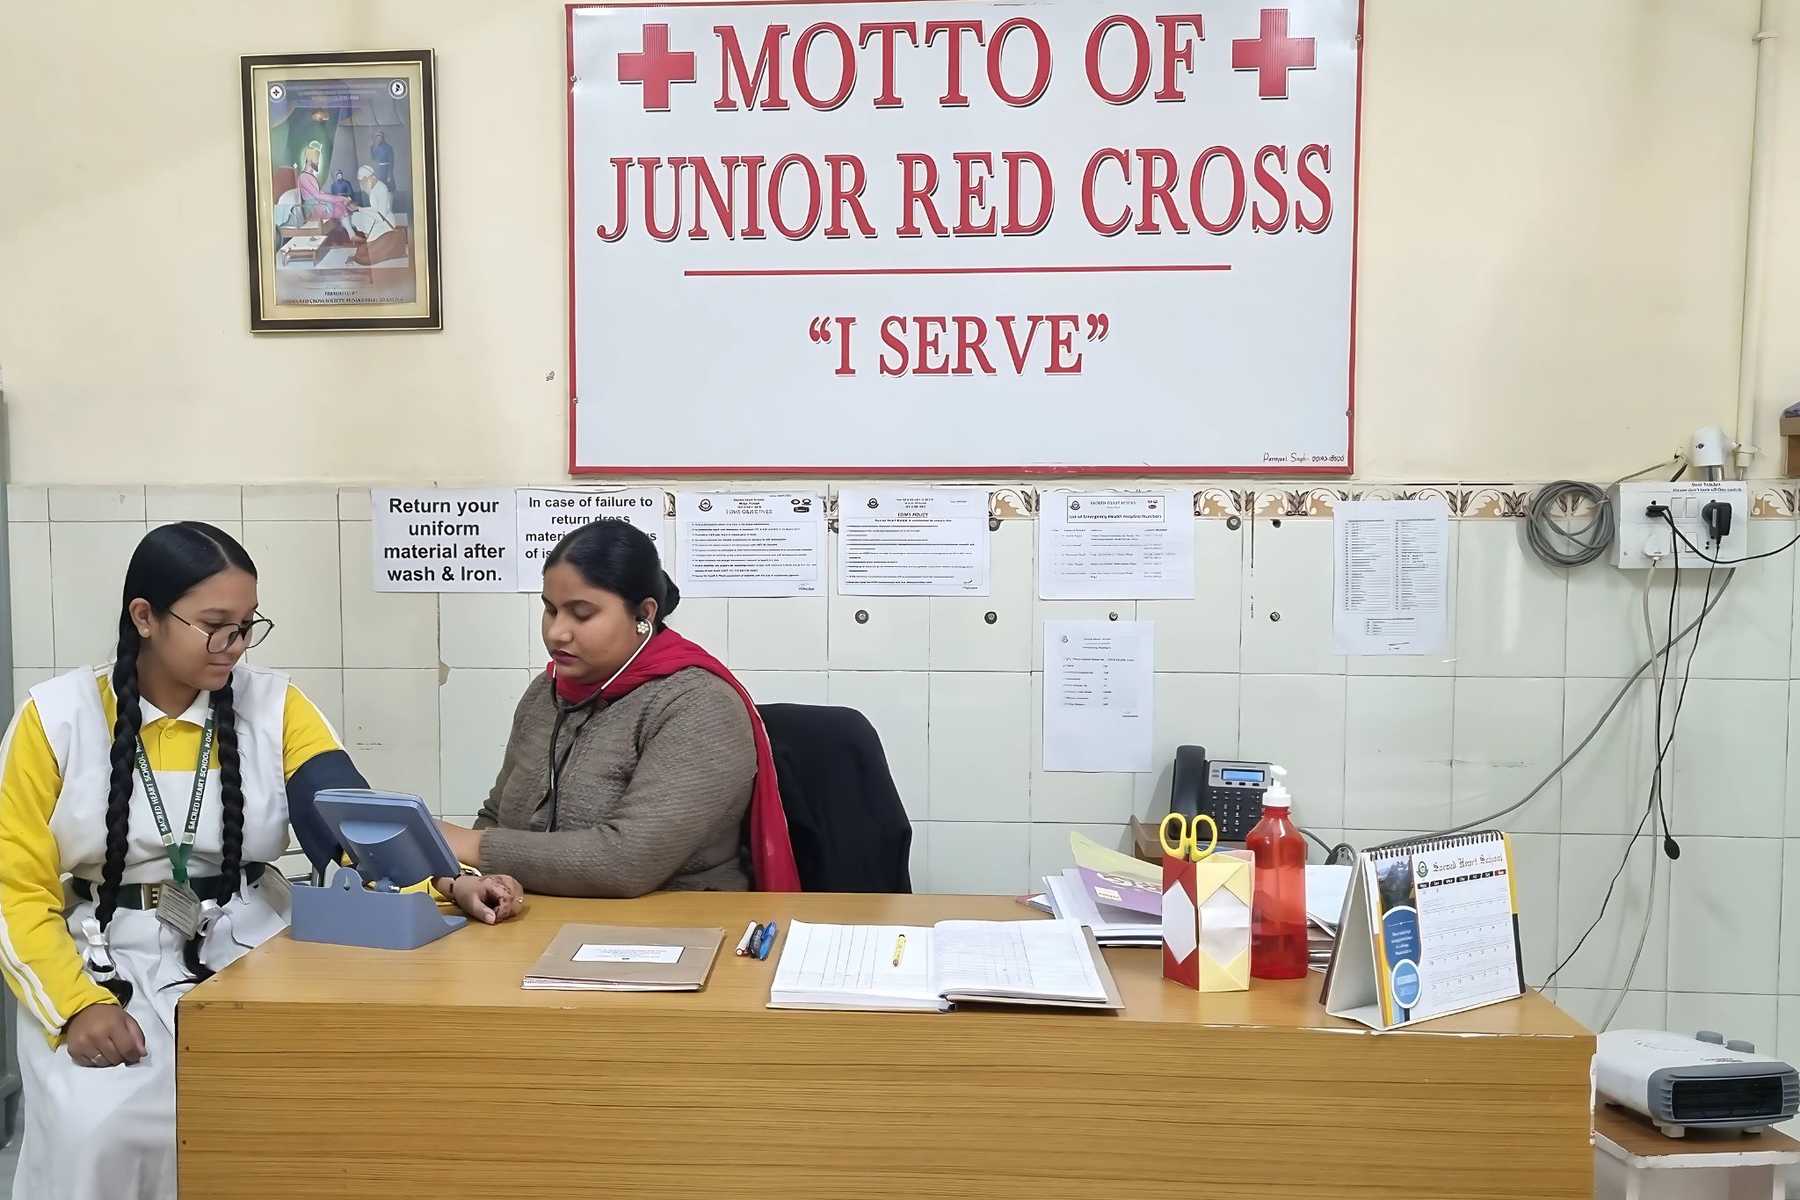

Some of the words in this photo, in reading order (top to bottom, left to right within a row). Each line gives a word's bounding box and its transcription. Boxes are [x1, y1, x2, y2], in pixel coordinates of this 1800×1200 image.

[713, 17, 1053, 112] MOTTO
[1085, 14, 1205, 106] OF
[597, 154, 878, 243] JUNIOR
[896, 151, 1055, 238] RED
[1082, 144, 1333, 237] CROSS
[389, 498, 451, 514] Return
[457, 501, 500, 518] your
[529, 497, 541, 508] In
[545, 499, 575, 508] case
[579, 497, 592, 508] of
[596, 497, 636, 508] failure
[640, 497, 653, 508] to
[409, 520, 480, 536] uniform
[551, 515, 590, 525] return
[384, 543, 457, 559] material
[464, 543, 506, 559] after
[525, 548, 538, 559] of
[387, 566, 435, 582] wash
[441, 566, 455, 582] &
[461, 566, 502, 582] Iron.
